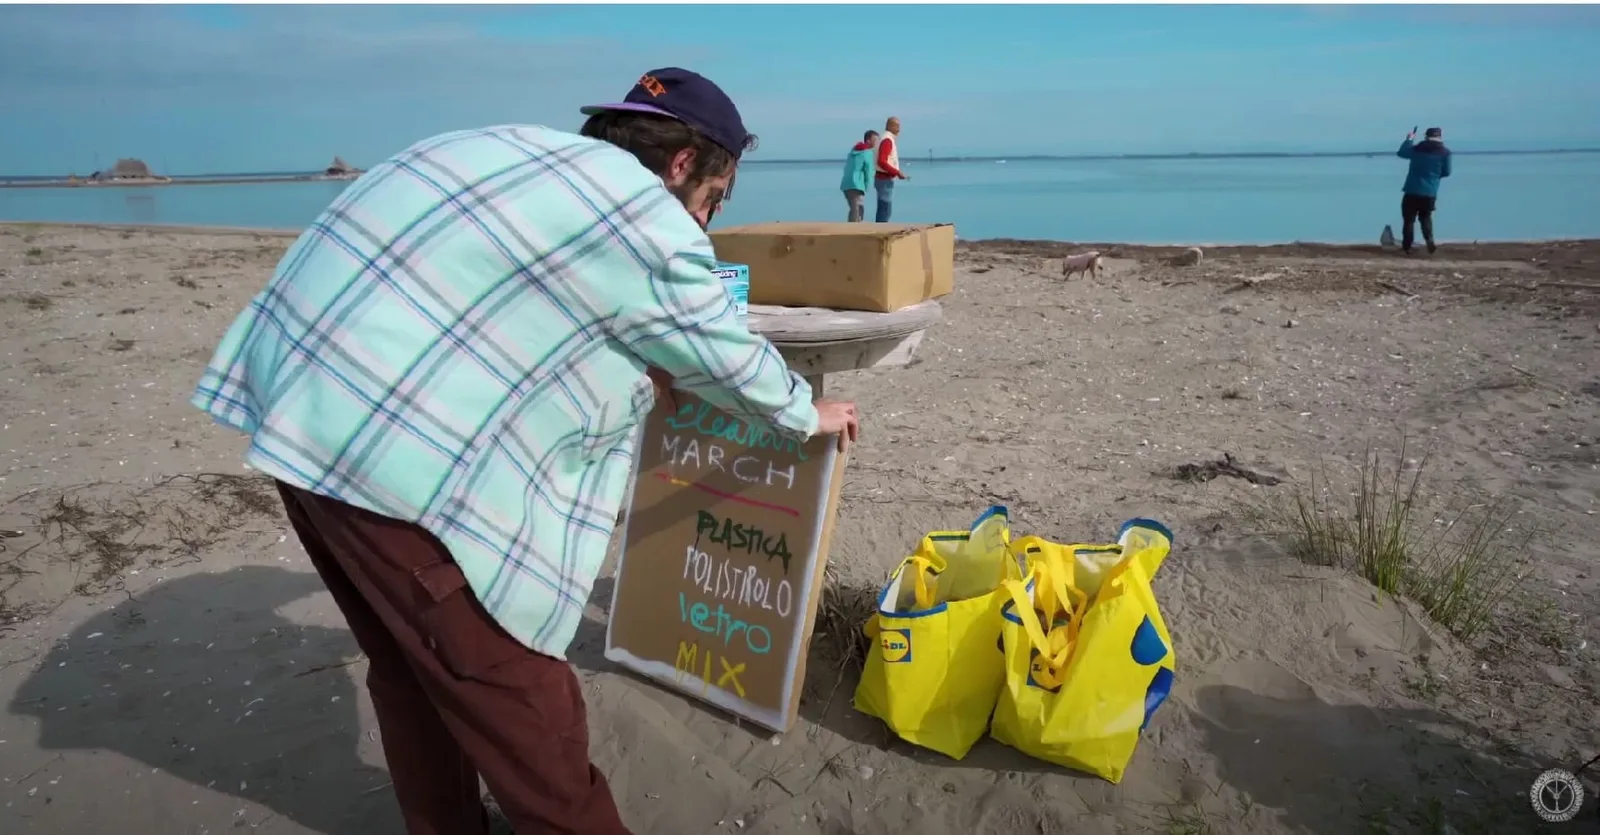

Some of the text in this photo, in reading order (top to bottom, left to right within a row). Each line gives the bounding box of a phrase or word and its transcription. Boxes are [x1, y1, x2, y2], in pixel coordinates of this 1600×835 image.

[661, 434, 795, 489] MARCH
[694, 510, 792, 574] PLASTICA
[683, 546, 792, 617] POLISTIROLO
[675, 640, 746, 698] MIX
